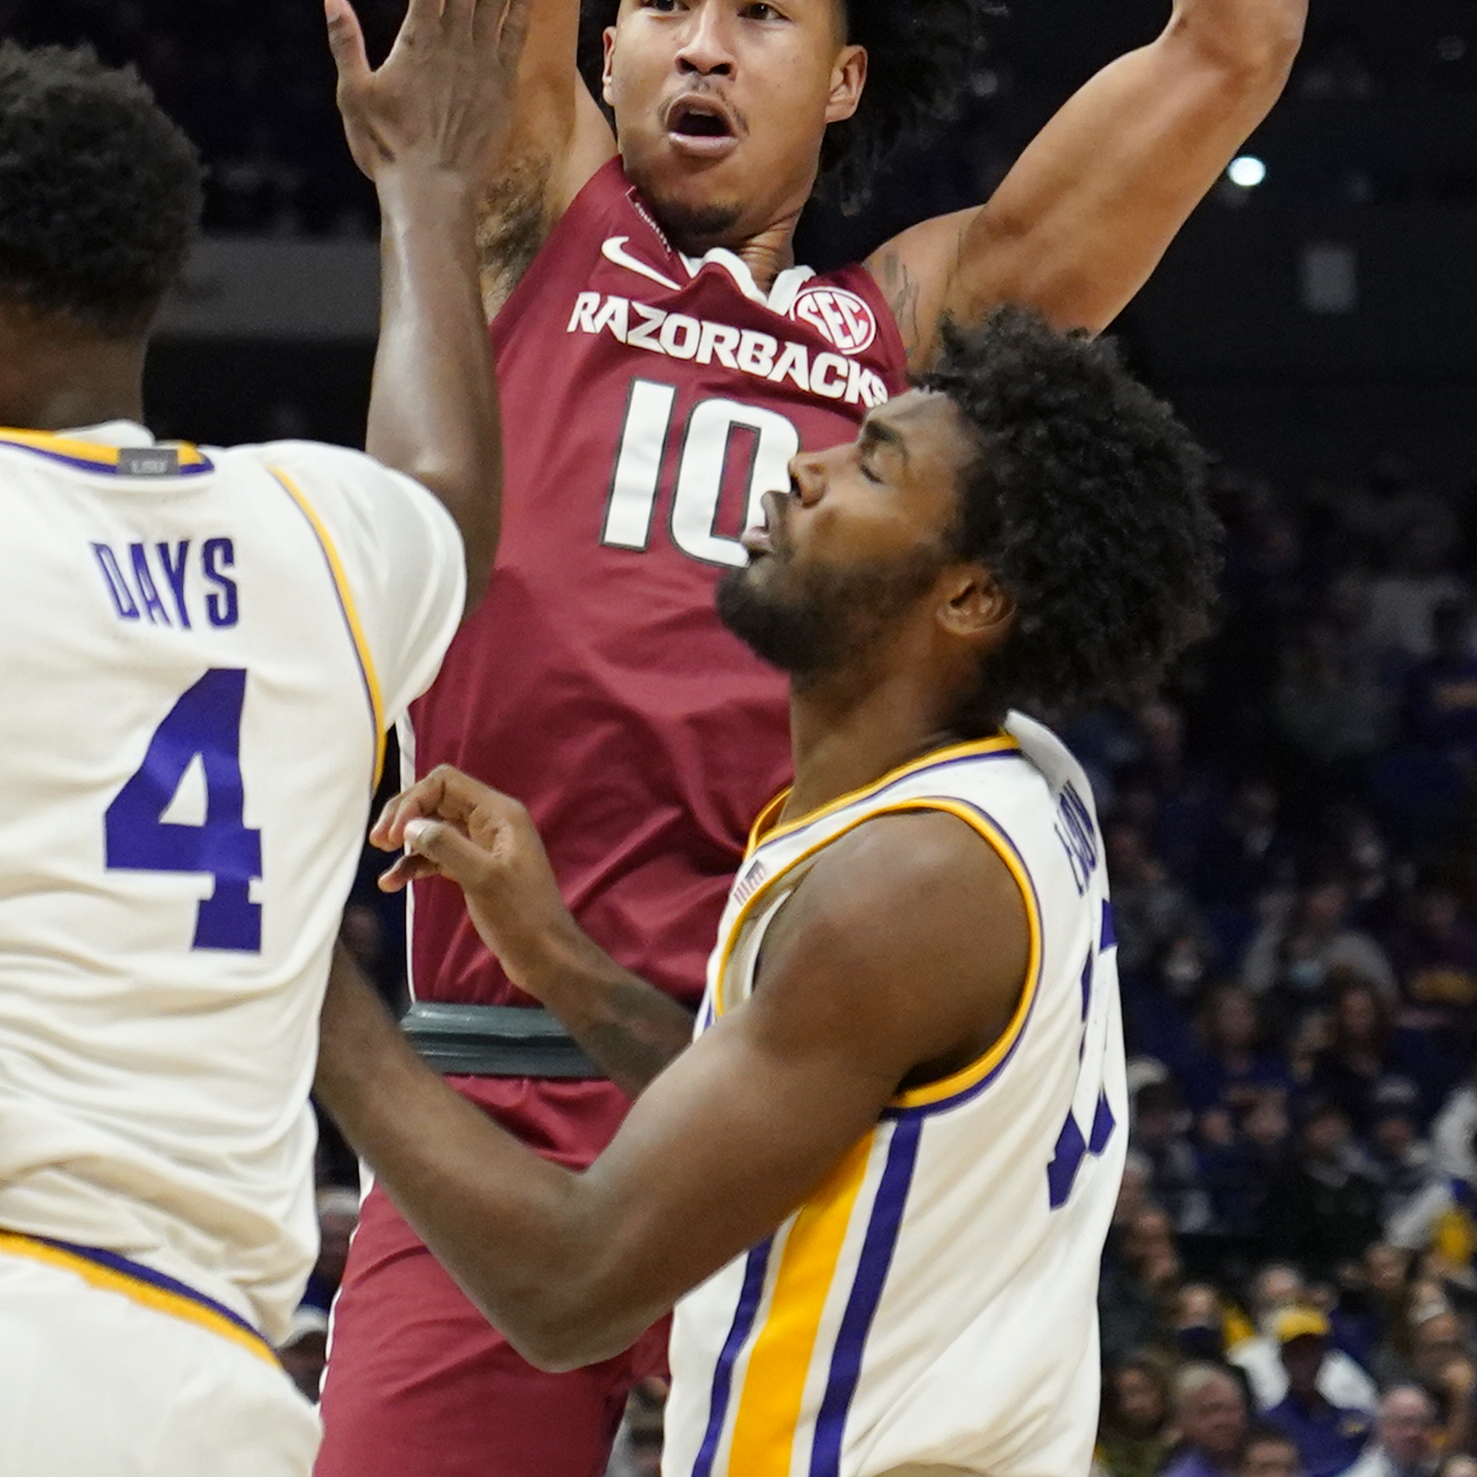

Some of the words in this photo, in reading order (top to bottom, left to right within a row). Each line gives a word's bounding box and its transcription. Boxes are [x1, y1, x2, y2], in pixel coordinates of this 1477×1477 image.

[567, 291, 888, 408] RAZORBACKS
[793, 289, 872, 351] SEC
[599, 376, 801, 570] 10
[90, 537, 239, 629] DAYS
[104, 667, 263, 954] 4
